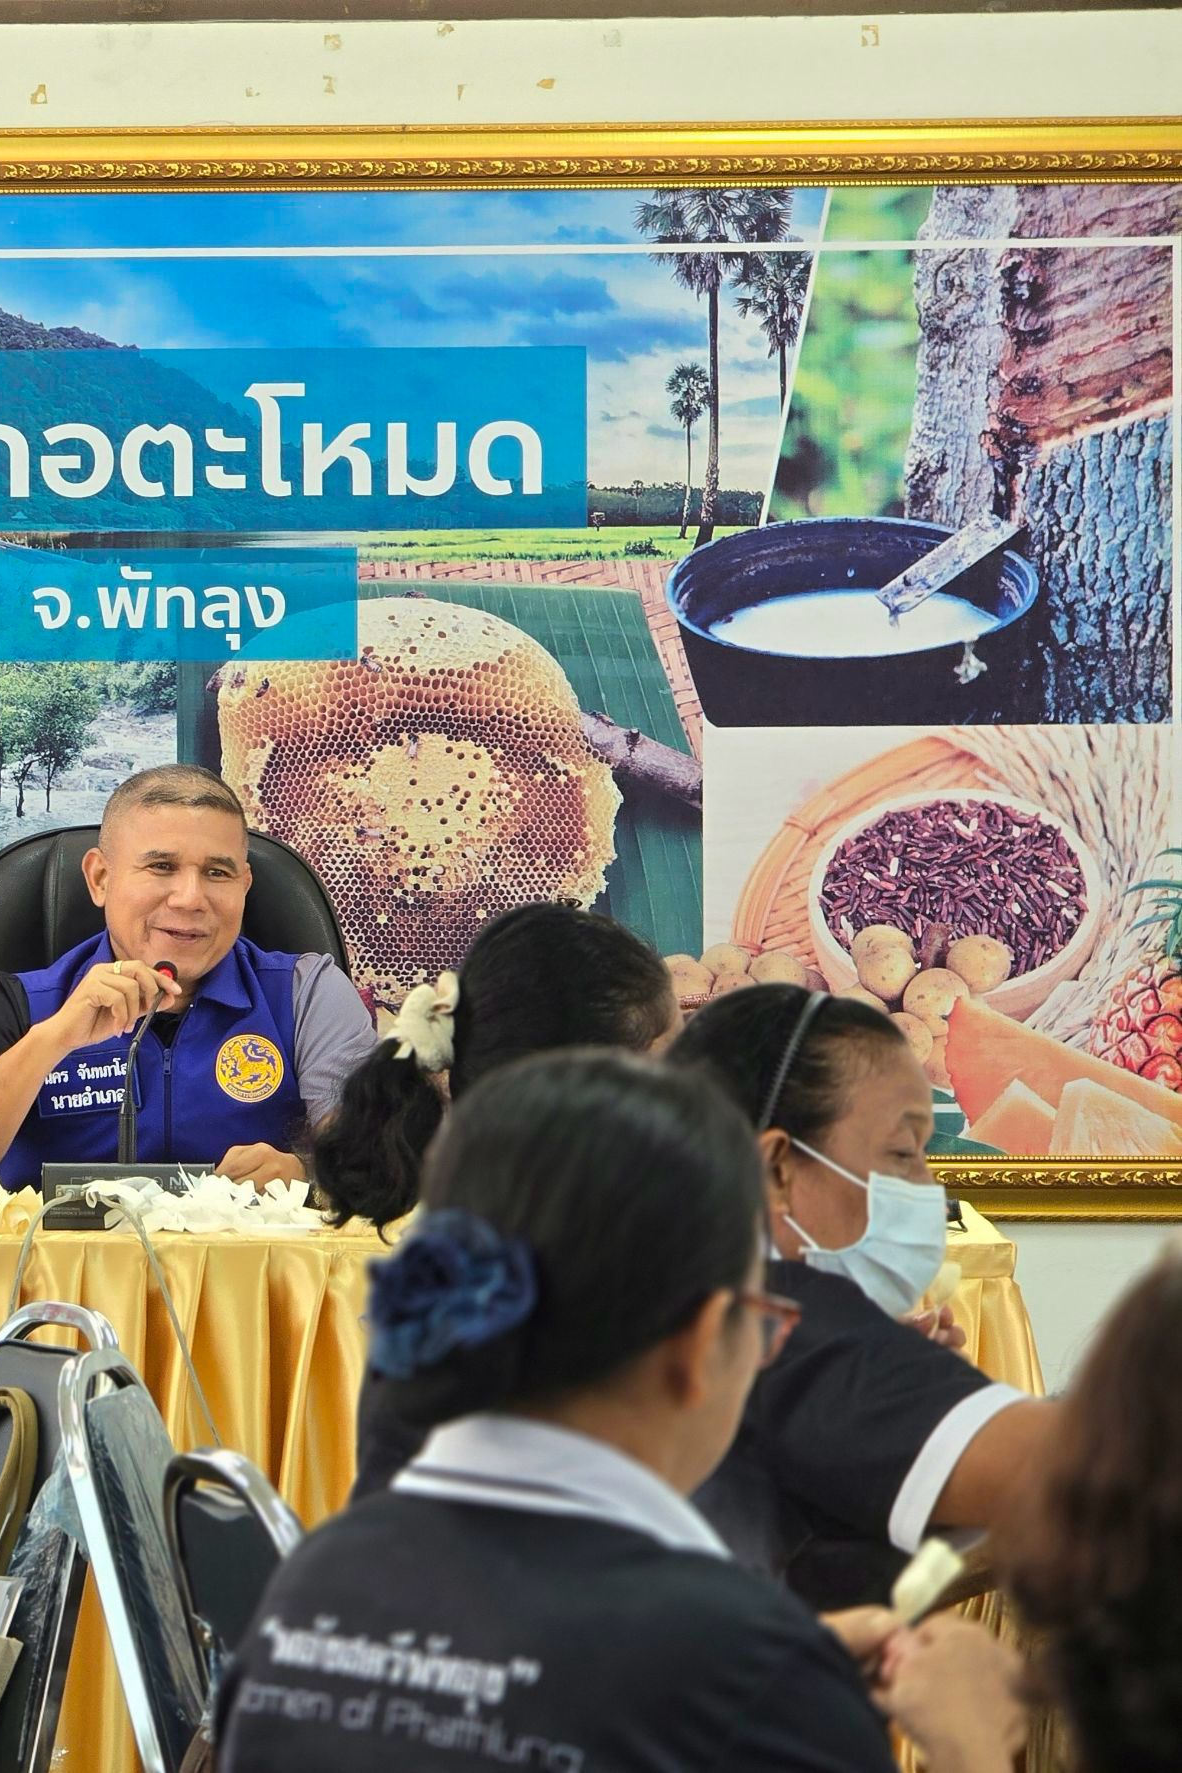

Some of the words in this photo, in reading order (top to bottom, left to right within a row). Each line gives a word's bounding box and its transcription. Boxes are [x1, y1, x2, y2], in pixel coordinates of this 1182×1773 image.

[33, 566, 286, 651] จ.พัทลุง
[50, 1086, 126, 1110] นายอำเภอ
[240, 1680, 332, 1721] omen
